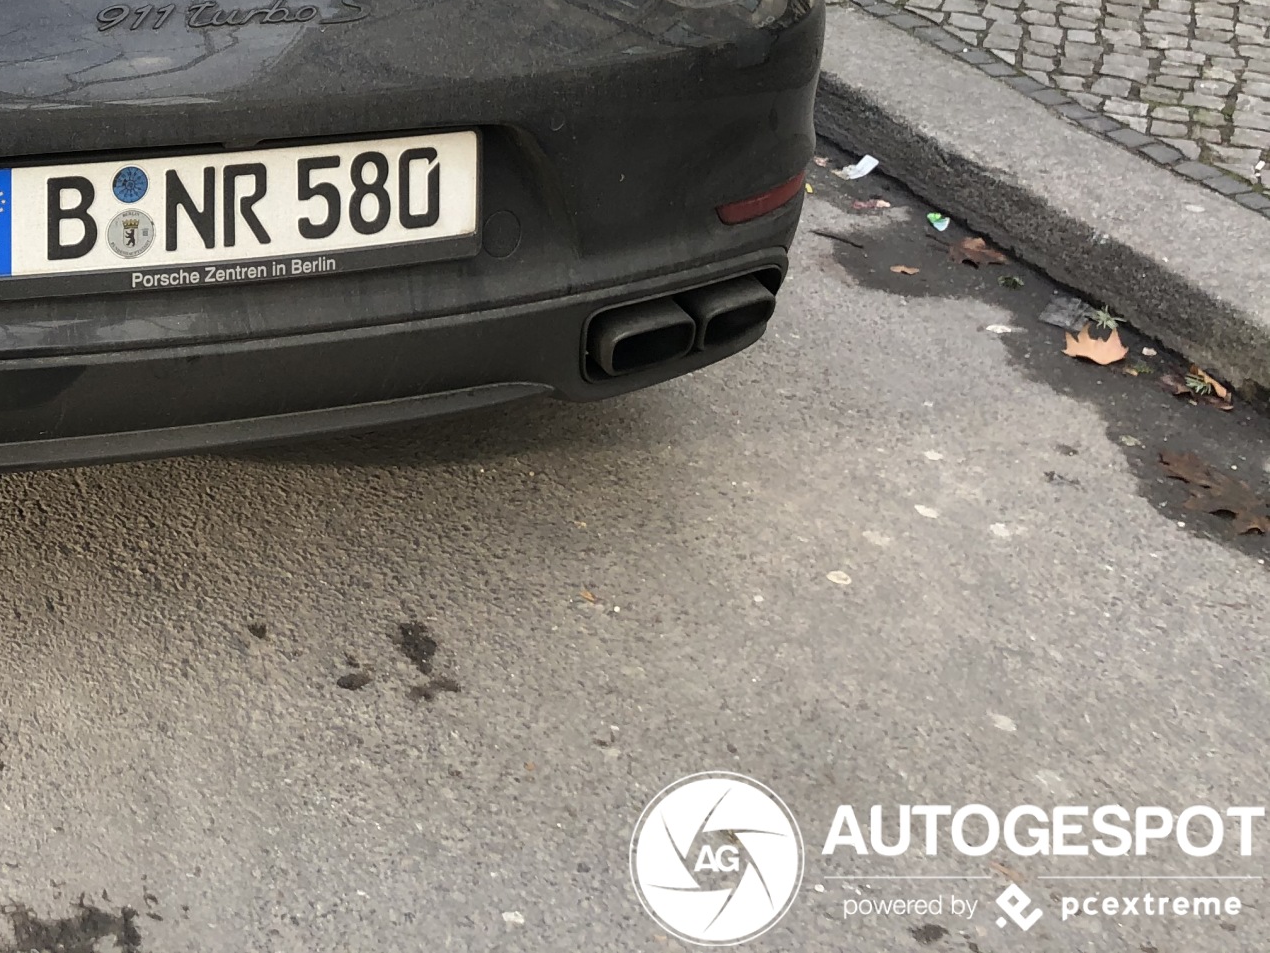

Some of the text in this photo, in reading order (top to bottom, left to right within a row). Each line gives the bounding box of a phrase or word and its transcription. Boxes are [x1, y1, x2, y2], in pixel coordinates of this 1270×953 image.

[95, 3, 175, 31] 911
[46, 175, 98, 261] B
[165, 161, 272, 251] NR
[297, 146, 440, 240] 580
[131, 256, 336, 289] Porsche Zentren in Berlin
